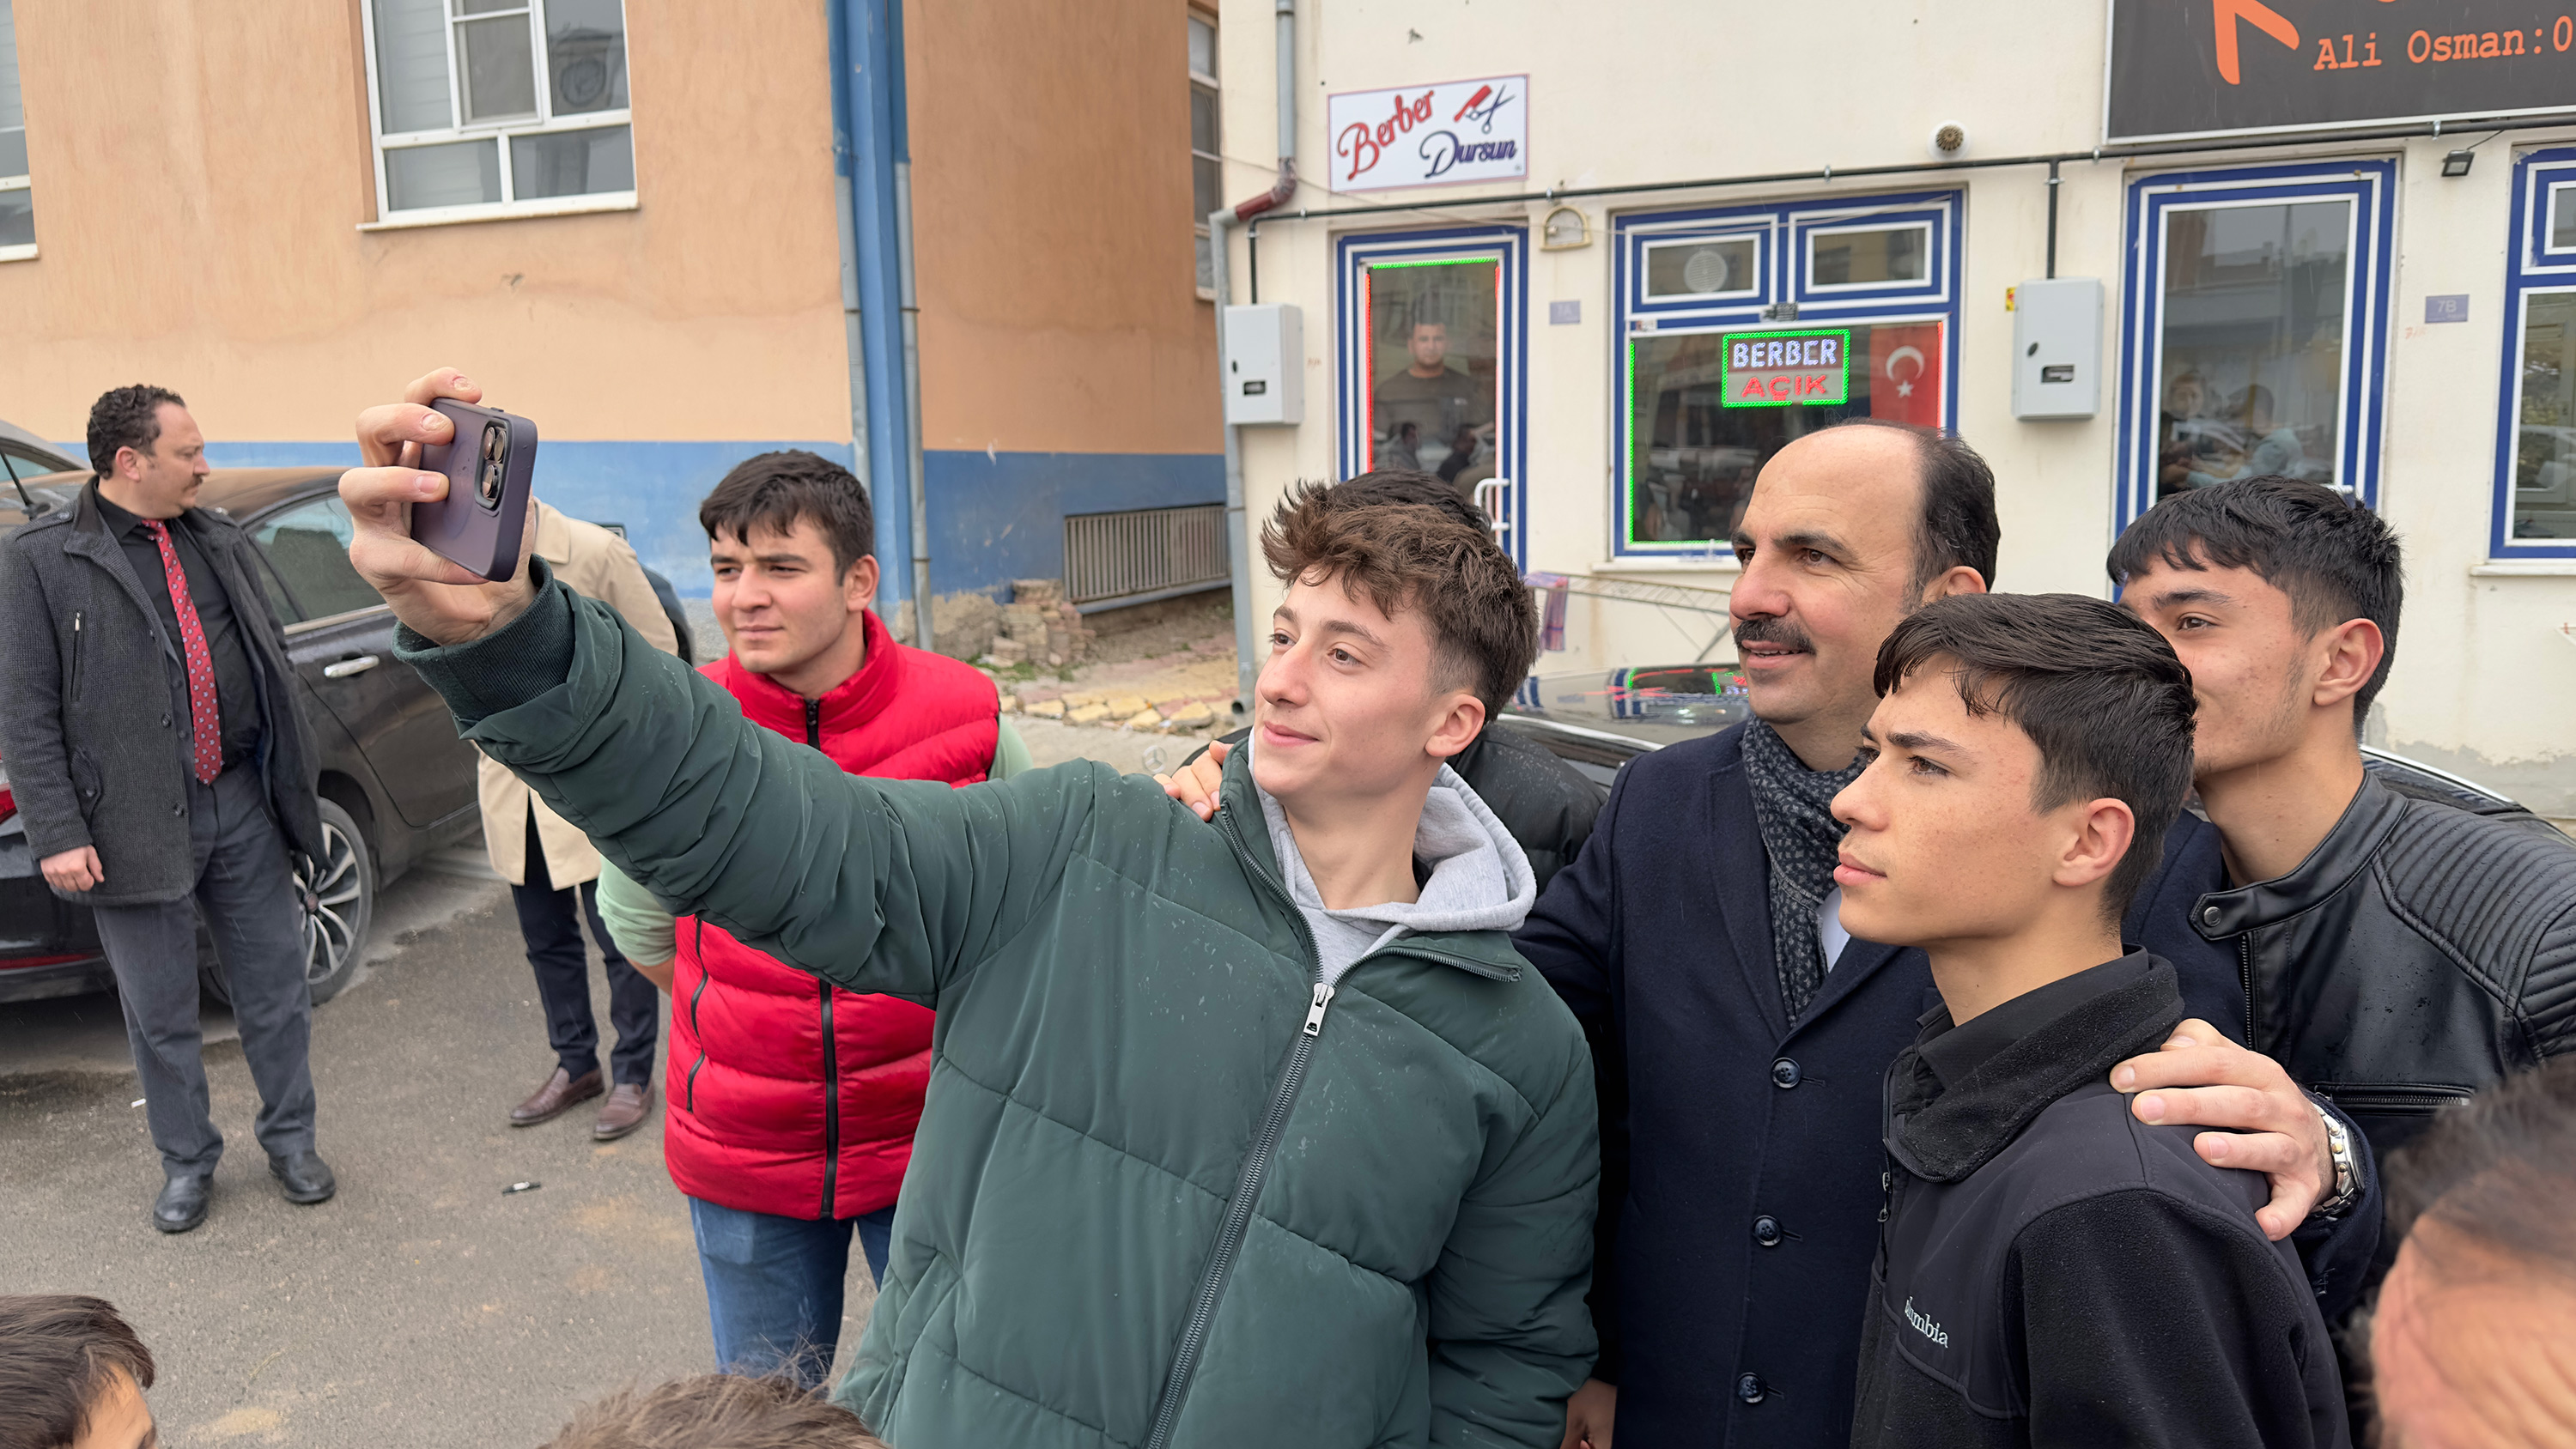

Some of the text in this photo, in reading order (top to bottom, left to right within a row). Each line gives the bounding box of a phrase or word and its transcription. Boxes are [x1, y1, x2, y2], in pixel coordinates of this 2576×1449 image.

[2313, 32, 2383, 71] Ali
[1337, 89, 1435, 181] Berber
[1419, 130, 1517, 179] Dursun
[2438, 299, 2458, 313] 7B
[1741, 374, 1827, 402] AÇIK
